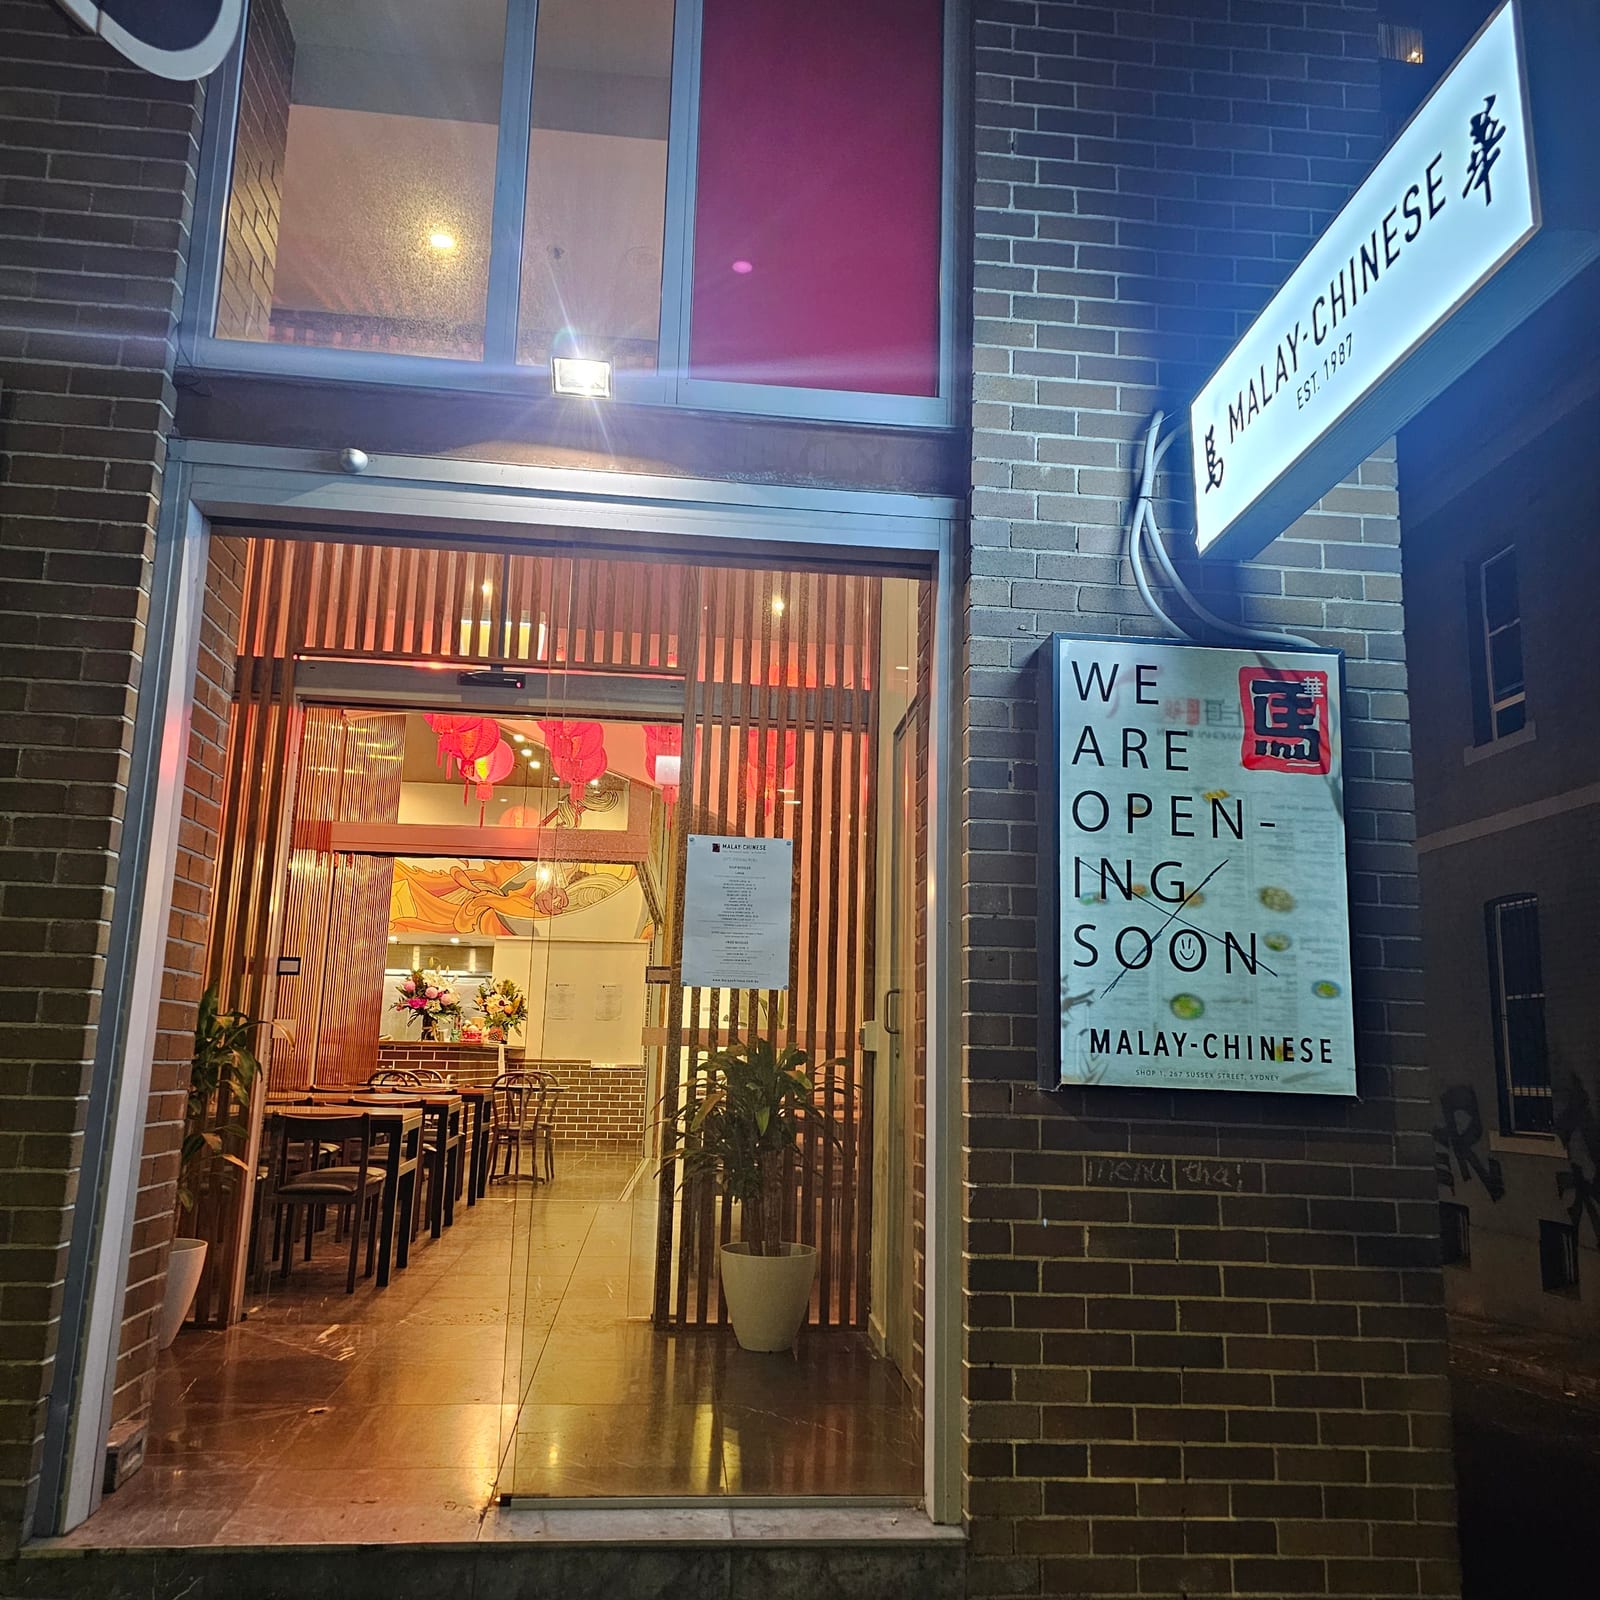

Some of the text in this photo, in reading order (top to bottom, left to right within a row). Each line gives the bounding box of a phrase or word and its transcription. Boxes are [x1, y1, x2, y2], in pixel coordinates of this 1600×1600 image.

[1228, 151, 1446, 444] MALAY-CHINESE
[1297, 332, 1352, 410] EST. 1987
[1071, 661, 1159, 705] WE
[1072, 725, 1189, 771] ARE
[1072, 790, 1276, 840] OPEN-
[1074, 856, 1185, 903] ING
[1073, 924, 1257, 975] SOON
[1090, 1028, 1332, 1064] MALAY-CHINESE
[1186, 1071, 1214, 1079] SUSSEX
[1249, 1073, 1280, 1081] SYDNEY
